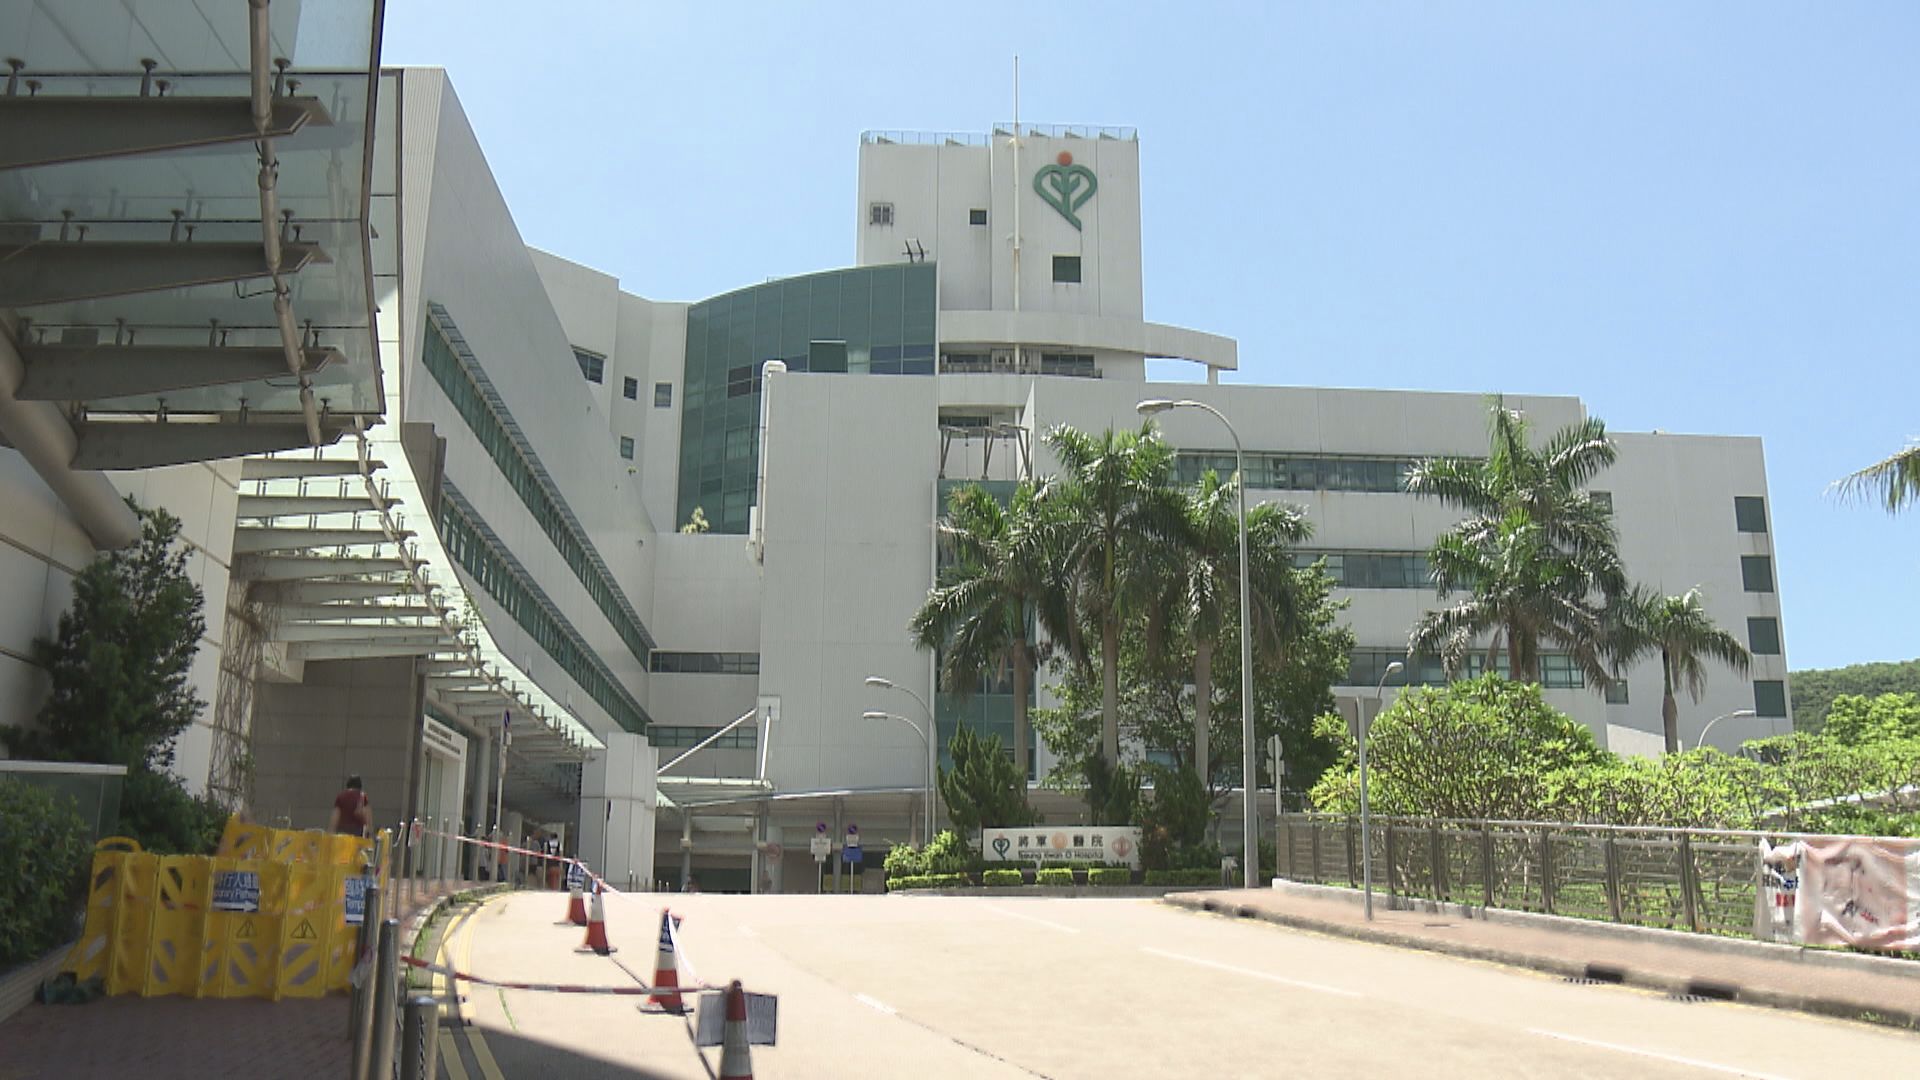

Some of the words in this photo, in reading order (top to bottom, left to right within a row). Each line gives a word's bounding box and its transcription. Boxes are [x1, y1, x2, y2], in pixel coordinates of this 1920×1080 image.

[1018, 851, 1042, 860] Tseung
[1044, 851, 1063, 860] Kwan
[1065, 851, 1073, 859] O
[1074, 851, 1104, 860] Hospital
